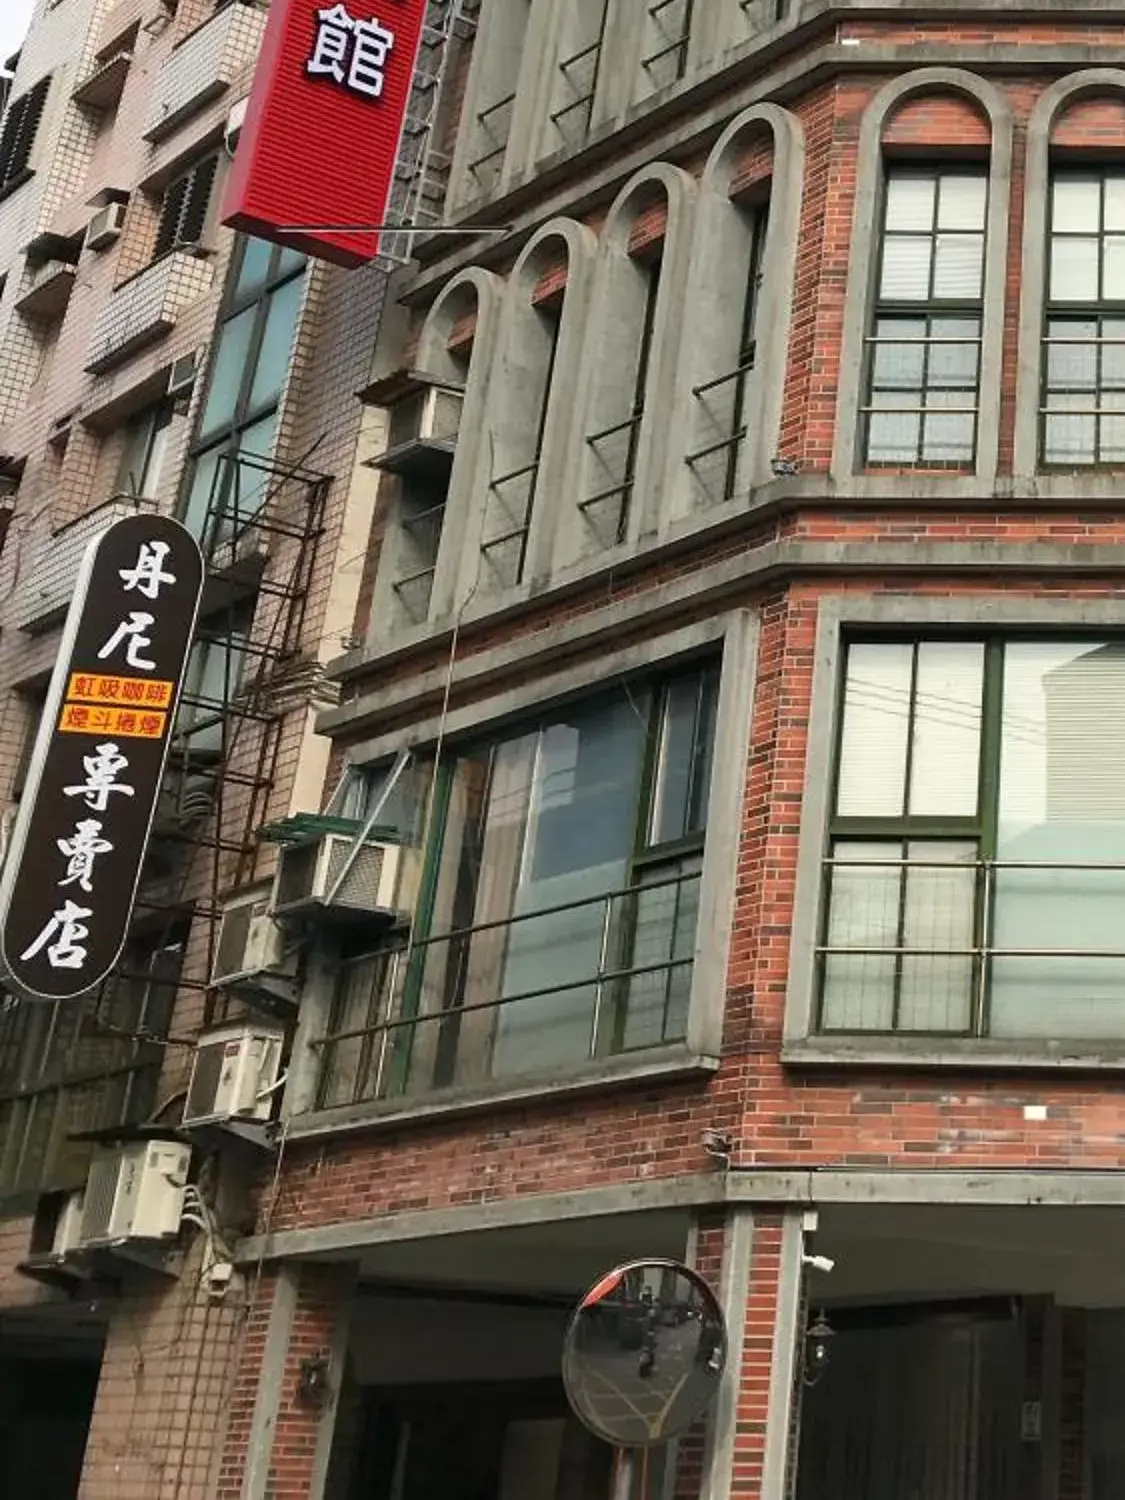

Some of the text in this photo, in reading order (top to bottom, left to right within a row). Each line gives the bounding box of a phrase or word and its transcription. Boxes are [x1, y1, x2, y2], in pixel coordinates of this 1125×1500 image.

[98, 541, 176, 669] 丹尼
[73, 676, 168, 702] 虹吸咖啡
[20, 742, 135, 969] 專賣店
